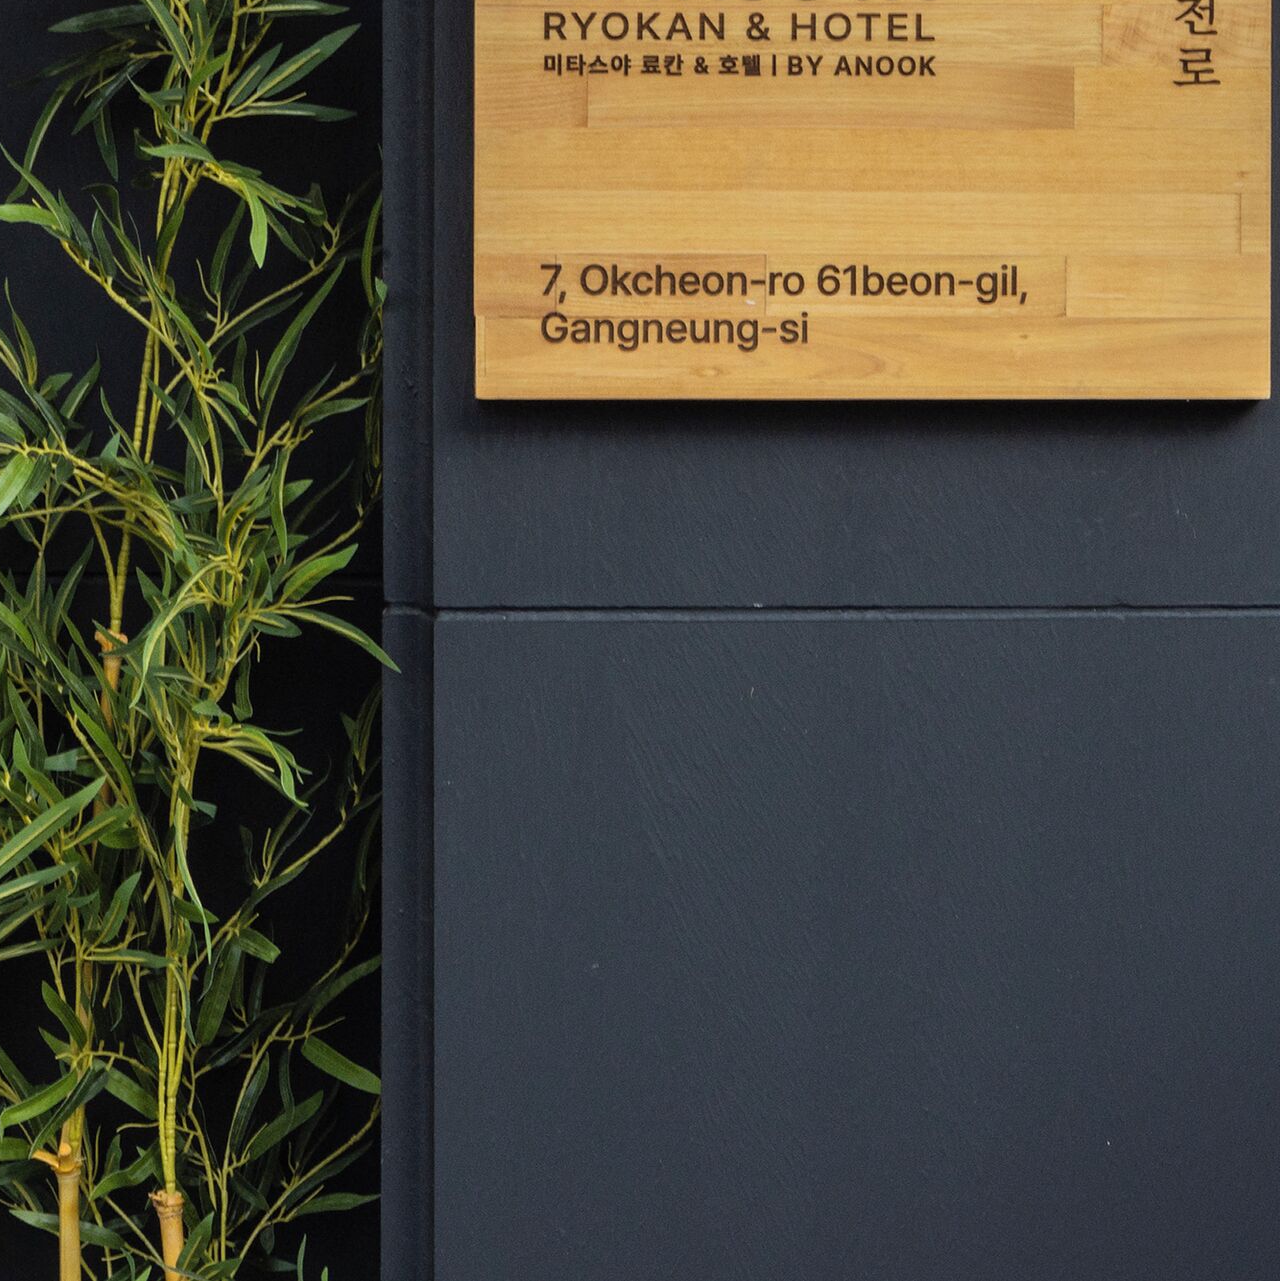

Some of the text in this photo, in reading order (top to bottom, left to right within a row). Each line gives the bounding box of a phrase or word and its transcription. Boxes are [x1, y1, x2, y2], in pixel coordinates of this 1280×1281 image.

[543, 11, 935, 42] RYOKAN & HOTEL
[543, 53, 936, 77] 미타스야 료칸 & 호텔 BY ANOOK
[540, 263, 1027, 305] 7, Okcheon-ro 61beon-gil,
[541, 311, 808, 352] Gangneung-si
